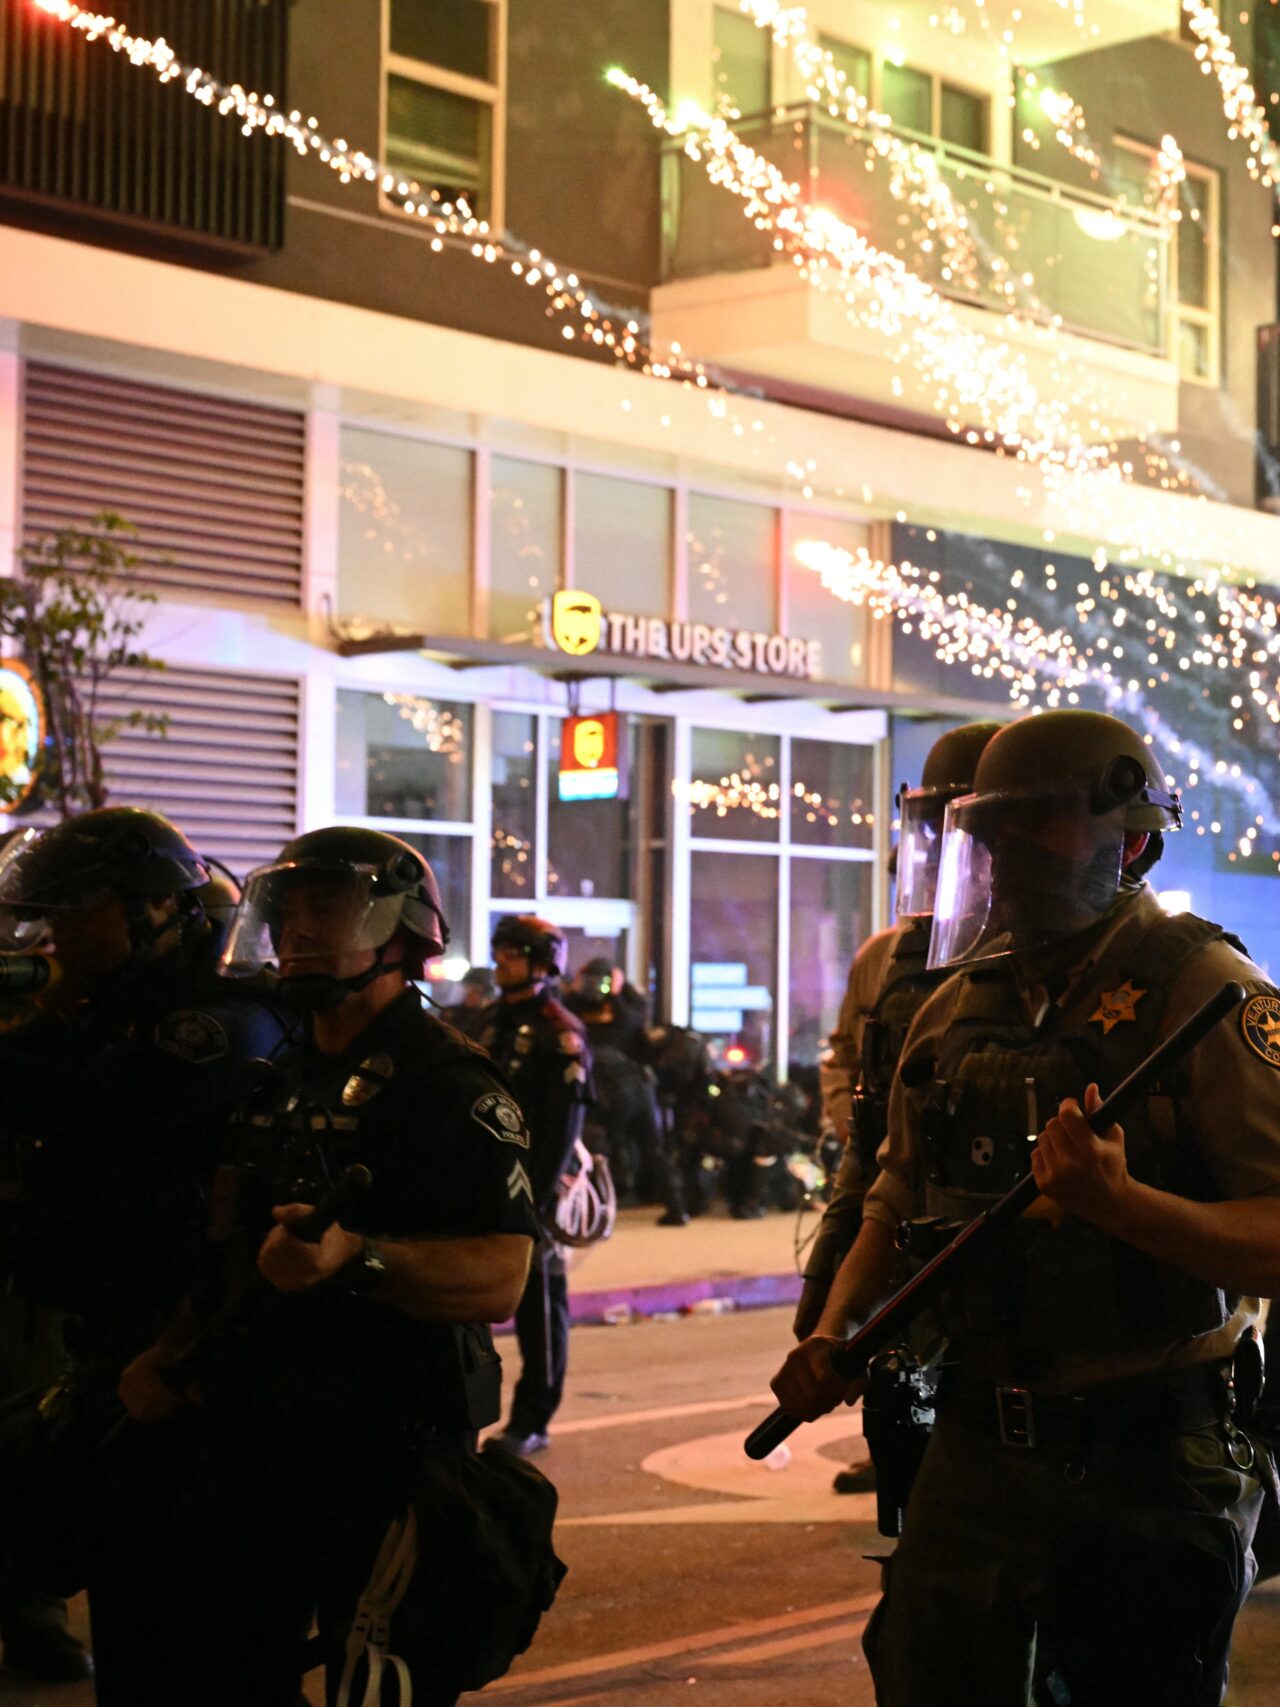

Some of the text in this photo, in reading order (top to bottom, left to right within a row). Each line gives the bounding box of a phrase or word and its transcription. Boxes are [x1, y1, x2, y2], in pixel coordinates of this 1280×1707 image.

[608, 612, 822, 678] THE UPS STORE
